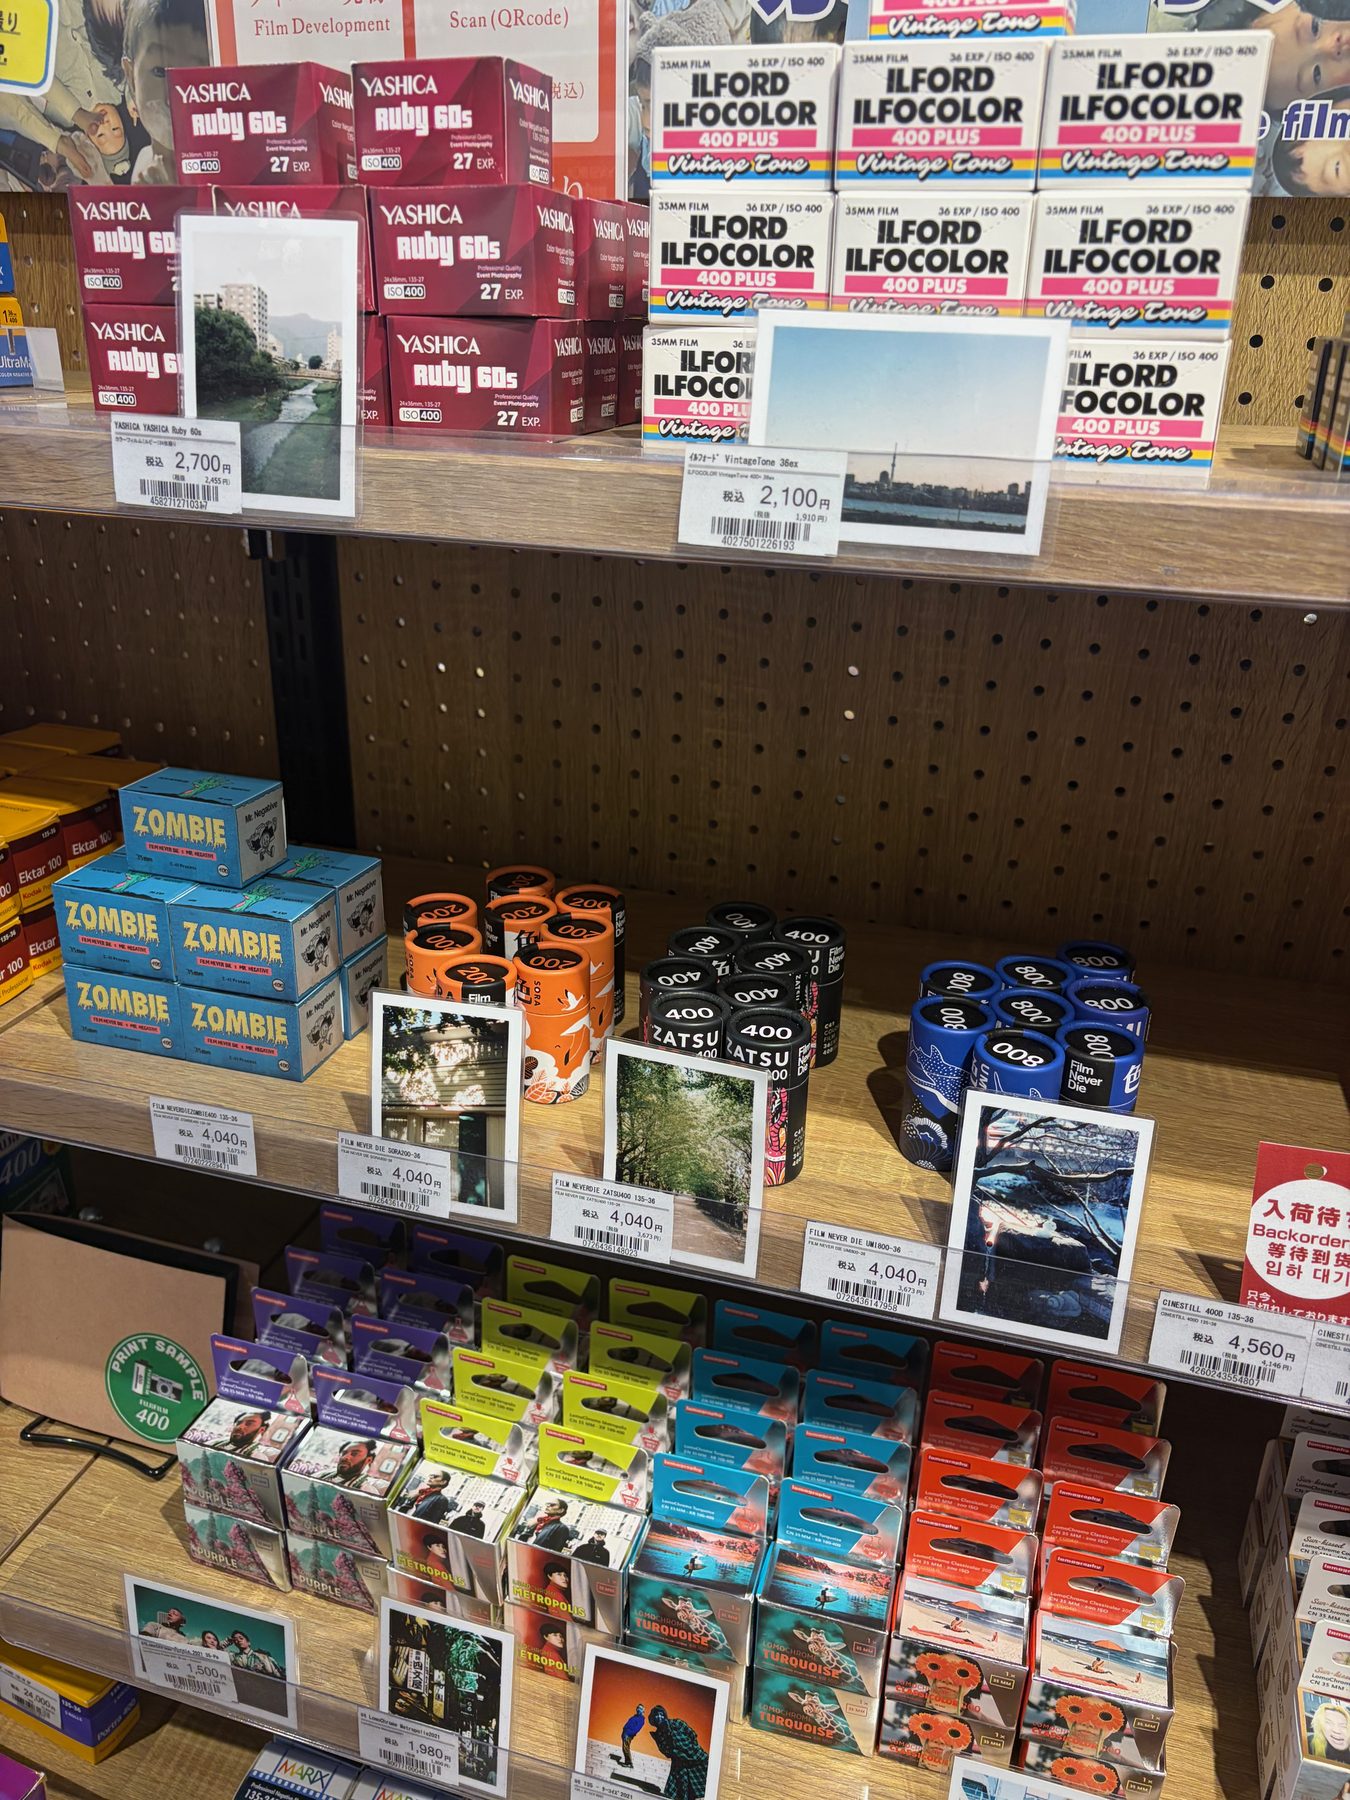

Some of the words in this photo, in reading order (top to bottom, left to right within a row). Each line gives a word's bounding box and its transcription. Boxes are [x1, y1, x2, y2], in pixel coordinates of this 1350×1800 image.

[254, 19, 289, 36] Film
[291, 17, 391, 37] Development
[360, 74, 438, 97] YASHICA
[691, 71, 789, 97] ILFORD
[886, 67, 995, 94] ILFORD
[1097, 62, 1214, 90] ILFORD
[175, 82, 251, 104] YASHICA
[375, 101, 429, 136] Ruby
[434, 104, 473, 129] 60s
[662, 100, 817, 127] ILFOCOLOR
[853, 97, 1023, 124] ILFOCOLOR
[1060, 92, 1243, 122] ILFOCOLOR
[191, 108, 245, 142] Ruby
[248, 111, 287, 134] 60s
[891, 129, 931, 146] 400
[934, 128, 981, 145] PLUS
[1100, 125, 1142, 143] 400
[1145, 124, 1197, 142] PLUS
[184, 161, 199, 172] ISO
[201, 160, 218, 172] 400
[270, 157, 290, 173] 27
[293, 161, 312, 173] EXP.
[366, 157, 380, 168] ISO
[382, 157, 400, 168] 400
[453, 152, 474, 170] 27
[477, 158, 496, 170] EXP.
[667, 152, 750, 181] Vintage
[752, 152, 810, 173] Tone
[1061, 149, 1161, 179] Vintage
[1163, 150, 1231, 172] Tone
[76, 201, 152, 220] YASHICA
[380, 204, 463, 225] YASHICA
[658, 201, 687, 211] 35MM
[689, 202, 709, 211] FILM
[746, 203, 758, 212] 36
[760, 203, 777, 212] EXP
[786, 204, 803, 213] ISO
[805, 204, 823, 214] 400
[690, 215, 788, 240] ILFORD
[877, 219, 982, 245] ILFORD
[1078, 218, 1192, 244] ILFORD
[93, 226, 146, 260] Ruby
[397, 230, 454, 266] Ruby
[459, 235, 501, 260] 60s
[661, 242, 815, 268] ILFOCOLOR
[845, 247, 1009, 274] ILFOCOLOR
[1043, 248, 1221, 275] ILFOCOLOR
[492, 272, 522, 280] Photography
[697, 271, 731, 287] 400
[734, 271, 777, 288] PLUS
[1082, 279, 1124, 295] 400
[1127, 279, 1175, 295] PLUS
[387, 286, 402, 297] ISO
[405, 286, 424, 297] 400
[480, 283, 502, 301] 27
[505, 289, 524, 300] EXP.
[1045, 300, 1140, 328] Vintage
[1143, 300, 1207, 322] Tone
[91, 322, 166, 342] YASHICA
[396, 334, 481, 355] YASHICA
[414, 360, 471, 394] Ruby
[477, 365, 518, 390] 60s
[403, 410, 419, 420] ISO
[420, 410, 440, 421] 400
[497, 410, 519, 426] 27
[521, 417, 541, 428] EXP.
[114, 421, 141, 431] YASHICA
[143, 423, 170, 434] YASHICA
[172, 426, 187, 436] Ruby
[190, 427, 202, 436] 60s
[145, 455, 164, 467] 税込
[175, 451, 231, 475] 2,700円
[725, 454, 776, 468] VintageTone
[779, 458, 799, 468] 36ex
[722, 490, 745, 503] 税込
[759, 485, 830, 510] 2,100円
[721, 536, 796, 551] 4027501226193
[253, 800, 279, 821] Negative
[132, 806, 227, 852] ZOMBIE
[72, 837, 98, 856] Ektar
[99, 830, 113, 847] 100
[18, 864, 46, 885] Ektar
[47, 854, 63, 872] 100
[64, 900, 160, 947] ZOMBIE
[183, 921, 283, 967] ZOMBIE
[785, 930, 830, 944] 400
[76, 981, 171, 1026] ZOMBIE
[468, 993, 491, 1004] Film
[533, 980, 542, 1007] SORA
[191, 1002, 289, 1049] ZOMBIE
[665, 1007, 714, 1020] 400
[652, 1024, 719, 1049] ZATSU
[740, 1024, 793, 1040] 400
[992, 1042, 1044, 1067] 800
[1068, 1070, 1103, 1087] Never
[1070, 1059, 1094, 1076] Film
[1067, 1080, 1087, 1094] Die
[202, 1128, 248, 1148] 4,040円
[340, 1137, 355, 1146] FILM
[356, 1140, 373, 1150] NEVER
[375, 1144, 385, 1153] DIE
[387, 1147, 421, 1160] SORA200-36
[392, 1167, 442, 1189] 4,040円
[555, 1178, 570, 1188] FILM
[571, 1181, 601, 1194] NEVERDIE
[602, 1187, 632, 1200] ZATSU400
[634, 1194, 656, 1205] 135-36
[610, 1210, 663, 1233] 4,040円
[809, 1228, 825, 1238] FILM
[828, 1232, 848, 1243] NEVER
[850, 1237, 863, 1246] DIE
[865, 1240, 901, 1254] UMI800-36
[838, 1260, 856, 1271] 税込
[869, 1262, 927, 1287] 4,040円
[1265, 1260, 1303, 1280] 입하
[1312, 1268, 1350, 1287] 대기
[836, 1292, 898, 1311] 0726436147958
[1162, 1298, 1201, 1313] CINESTILL
[1205, 1307, 1224, 1318] 400D
[1227, 1312, 1254, 1324] 135-36
[1193, 1332, 1214, 1345] 税込
[1228, 1334, 1296, 1362] 4,560円
[111, 1338, 149, 1374] PRINT
[154, 1340, 205, 1402] SAMPLE
[1189, 1365, 1260, 1387] 4260243554807
[135, 1407, 170, 1432] 400
[397, 1560, 465, 1588] METROPOLIS
[512, 1586, 586, 1618] METROPOLIS
[635, 1617, 709, 1647] TURQUOISE
[763, 1649, 841, 1680] TURQUOISE
[759, 1711, 834, 1740] TURQUOISE
[408, 1739, 452, 1763] 1,980円
[278, 1759, 330, 1789] MARIX
